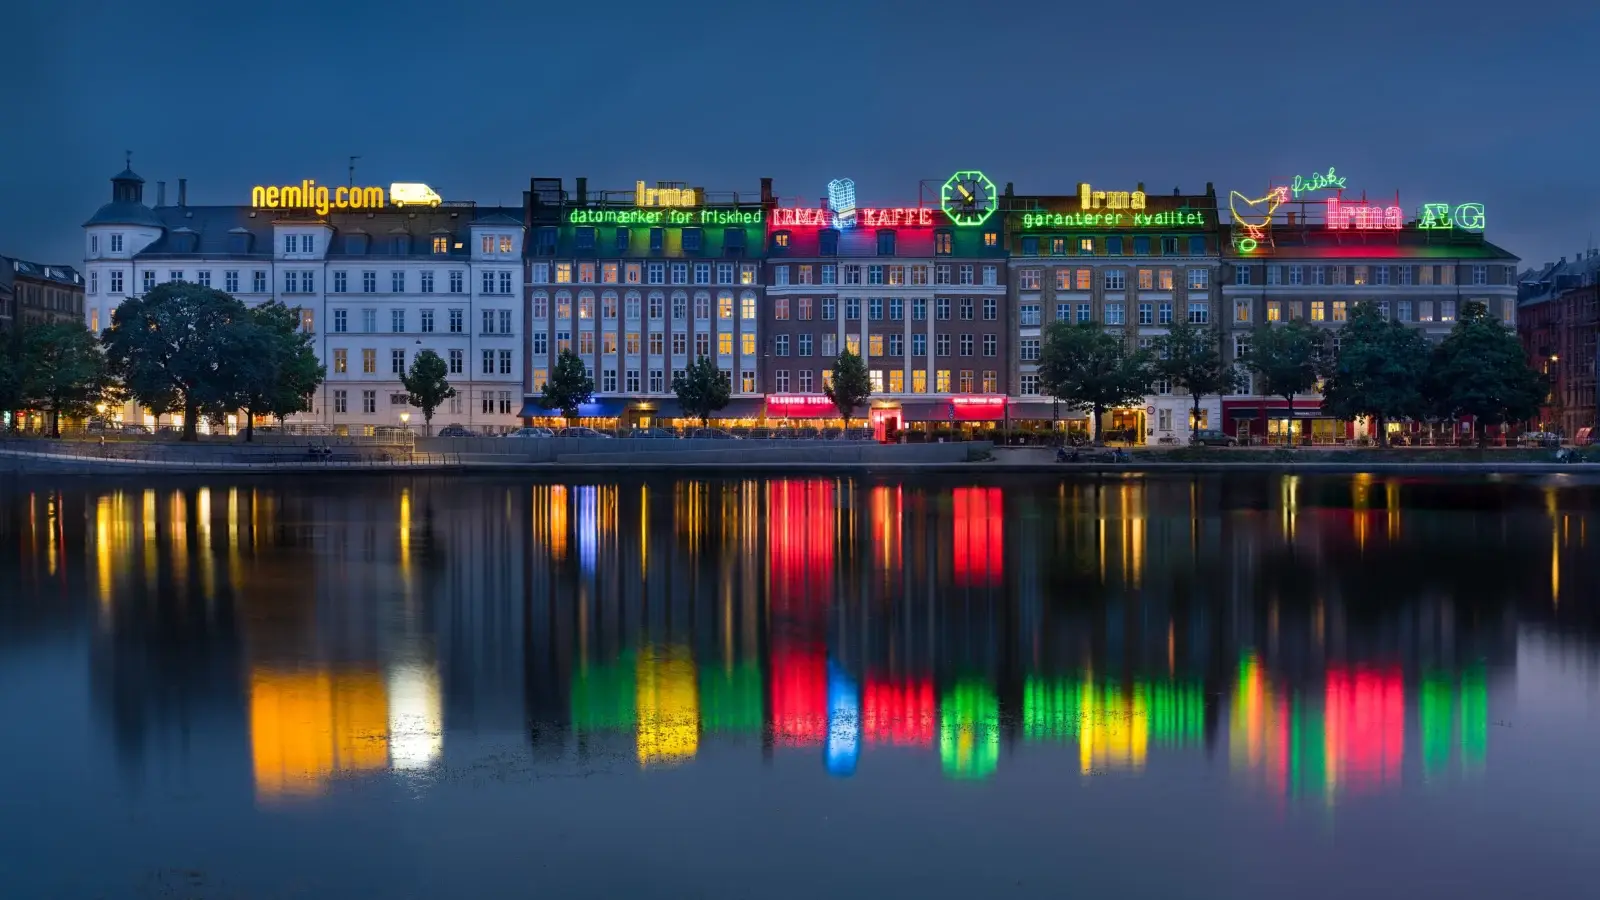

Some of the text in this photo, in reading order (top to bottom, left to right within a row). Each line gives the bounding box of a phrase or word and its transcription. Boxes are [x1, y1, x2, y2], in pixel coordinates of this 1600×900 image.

[636, 180, 696, 207] Irma
[1291, 167, 1347, 198] friske
[252, 179, 384, 216] nemlig.com
[1081, 183, 1146, 210] Irma
[570, 208, 762, 225] datomærker for friskhed
[772, 207, 933, 226] IRMA KAFFE
[1023, 210, 1205, 229] garanterer kvalitet
[1327, 198, 1403, 230] Irma
[1418, 203, 1486, 230] ÆG
